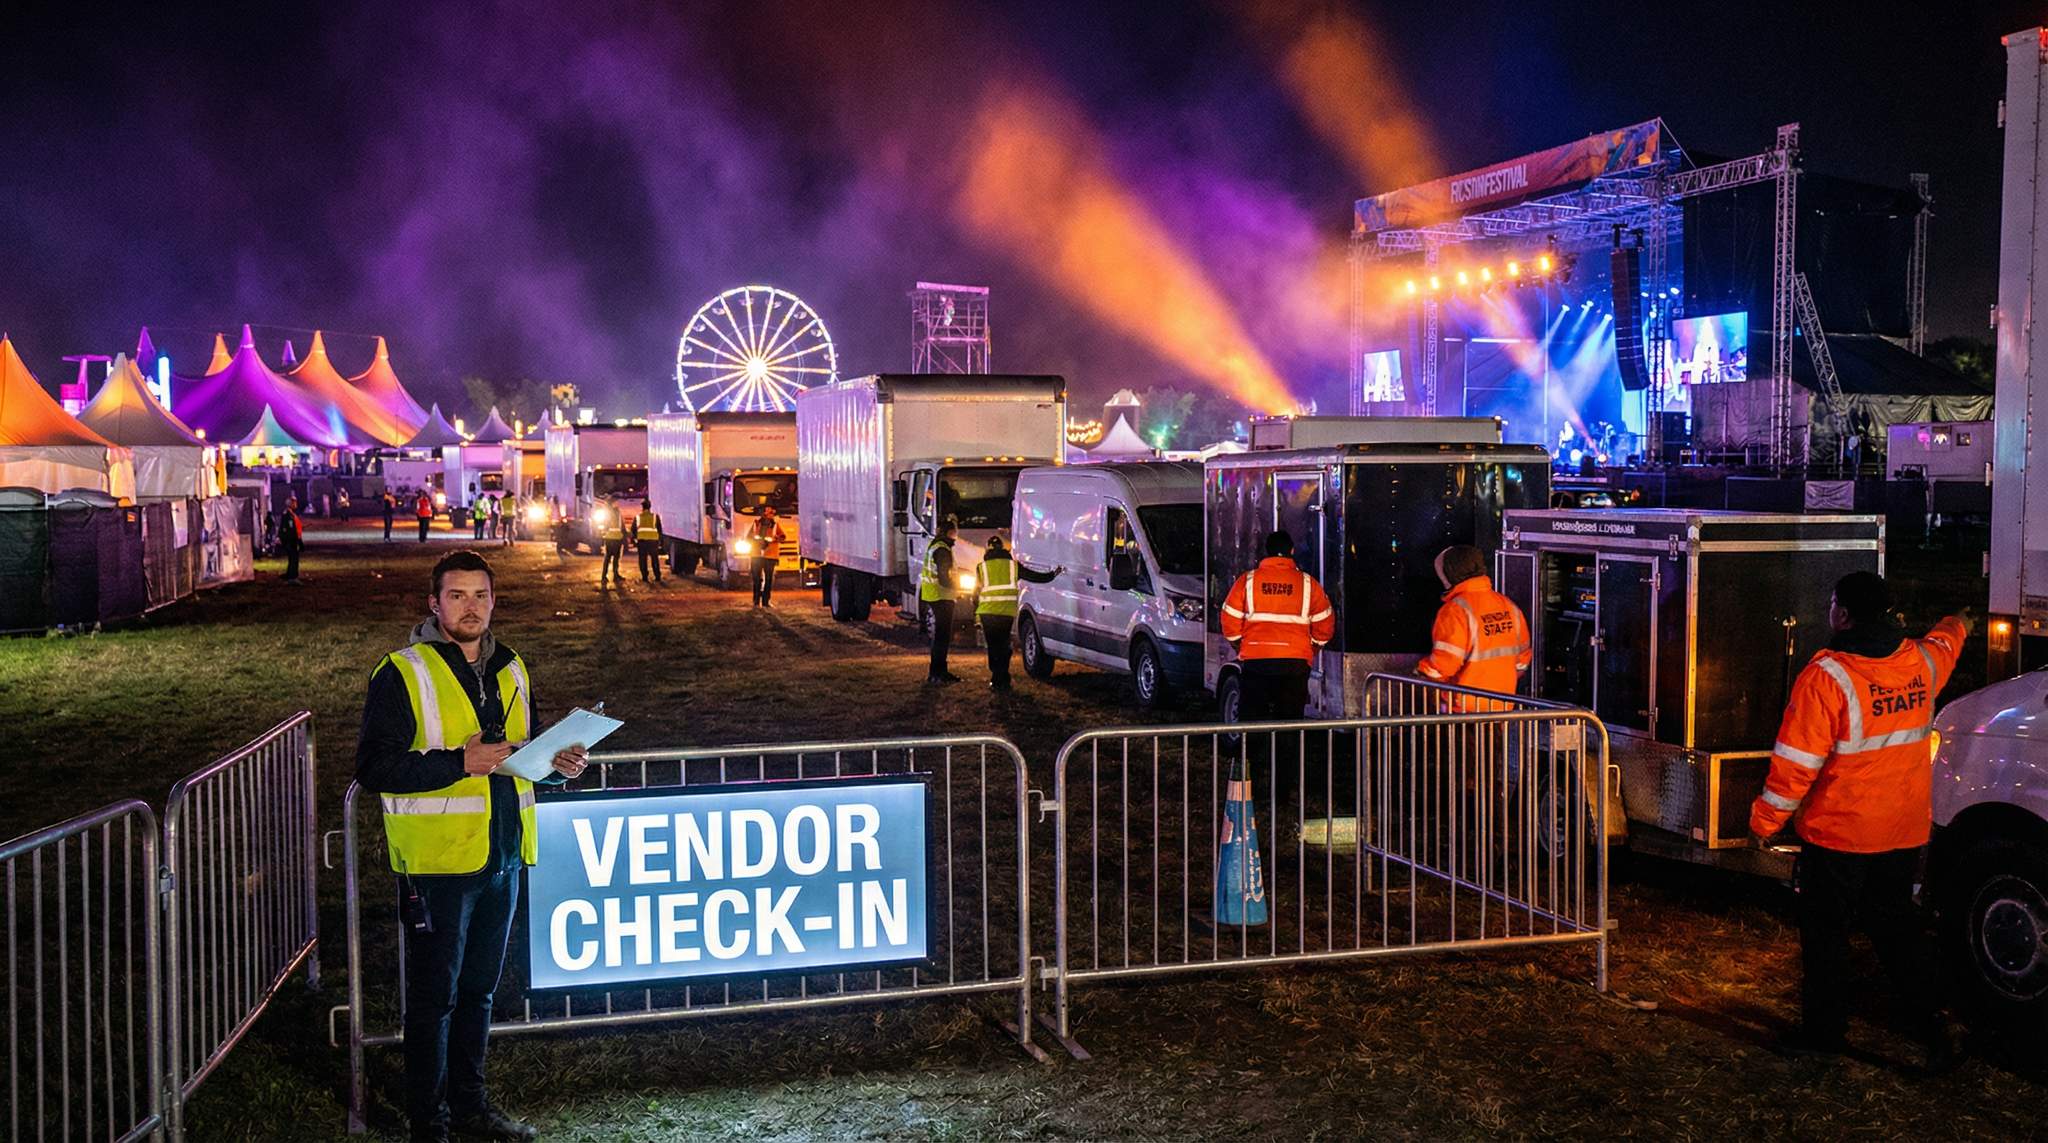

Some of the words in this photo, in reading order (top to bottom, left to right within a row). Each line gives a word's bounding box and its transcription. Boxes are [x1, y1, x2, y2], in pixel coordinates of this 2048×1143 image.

[1484, 621, 1512, 637] STAFF
[1872, 690, 1927, 717] STAFF
[572, 803, 882, 888] VENDOR
[549, 878, 909, 971] CHECK-IN
